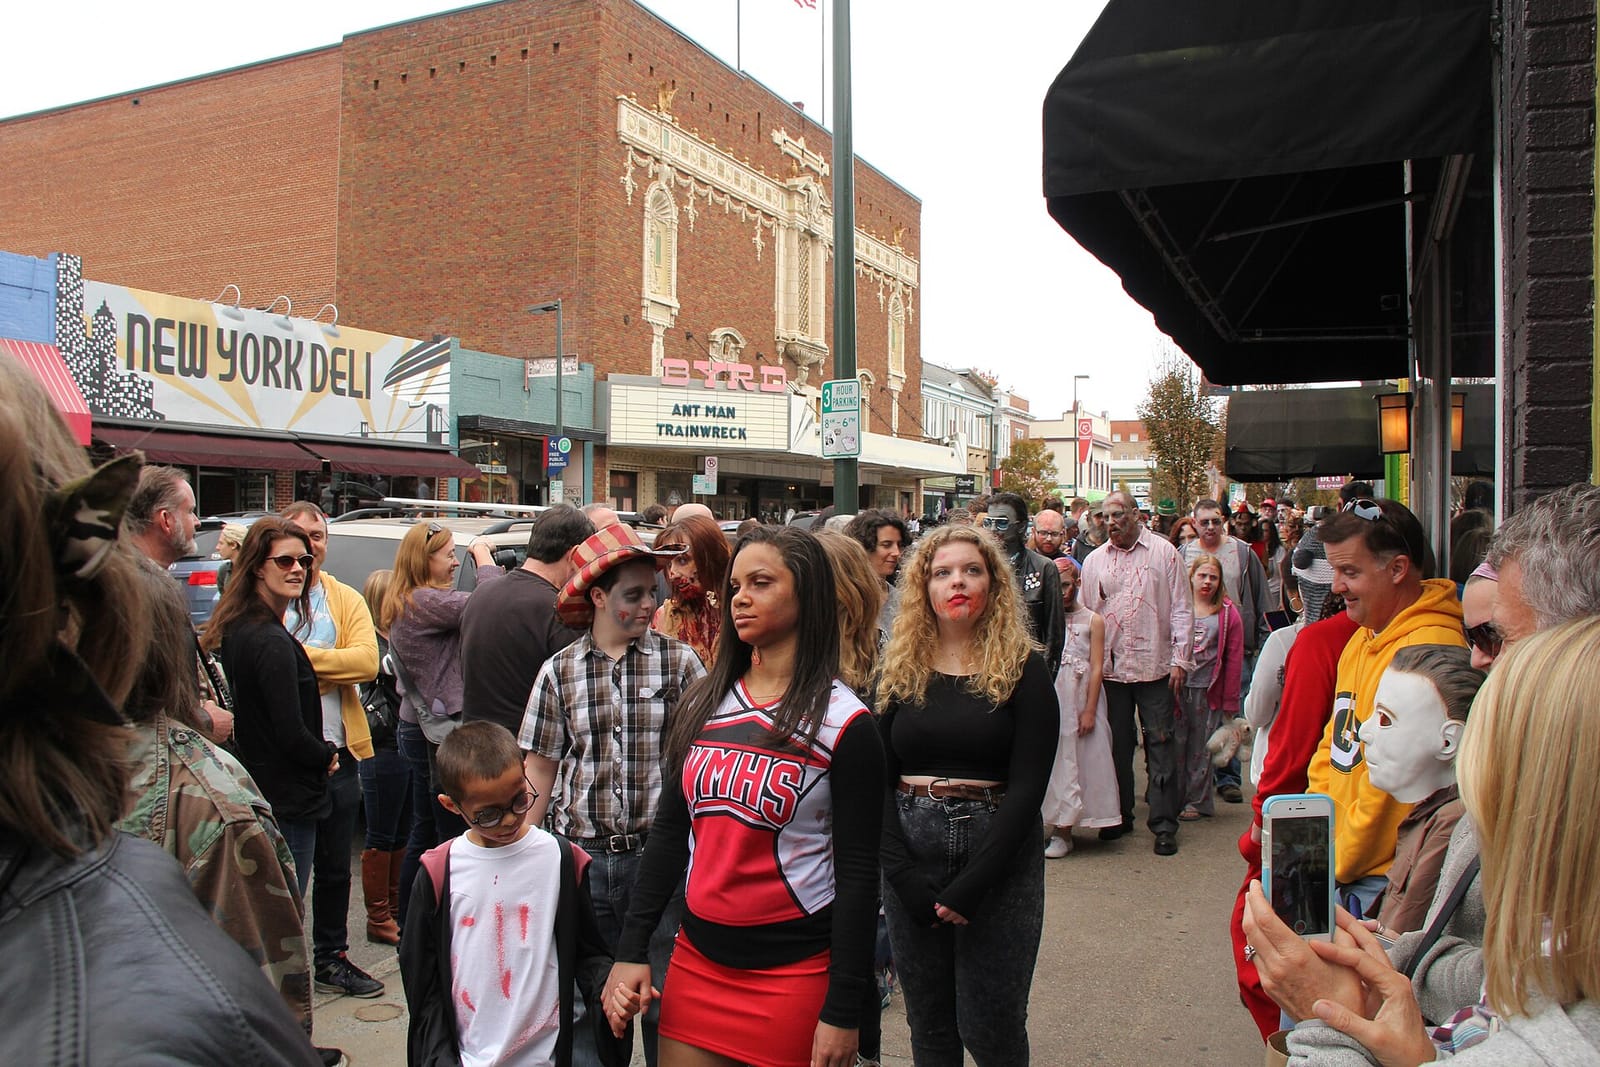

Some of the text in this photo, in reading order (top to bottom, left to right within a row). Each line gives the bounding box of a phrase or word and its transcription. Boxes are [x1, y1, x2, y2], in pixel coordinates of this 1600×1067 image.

[126, 312, 372, 400] NEW YORK DELI
[660, 358, 787, 393] BYRD
[823, 388, 831, 408] 3
[836, 384, 853, 395] HOUR
[671, 403, 736, 419] ANT MAN
[832, 396, 857, 407] PARKING
[656, 422, 747, 440] TRAINWRECK
[682, 745, 806, 830] WMHS
